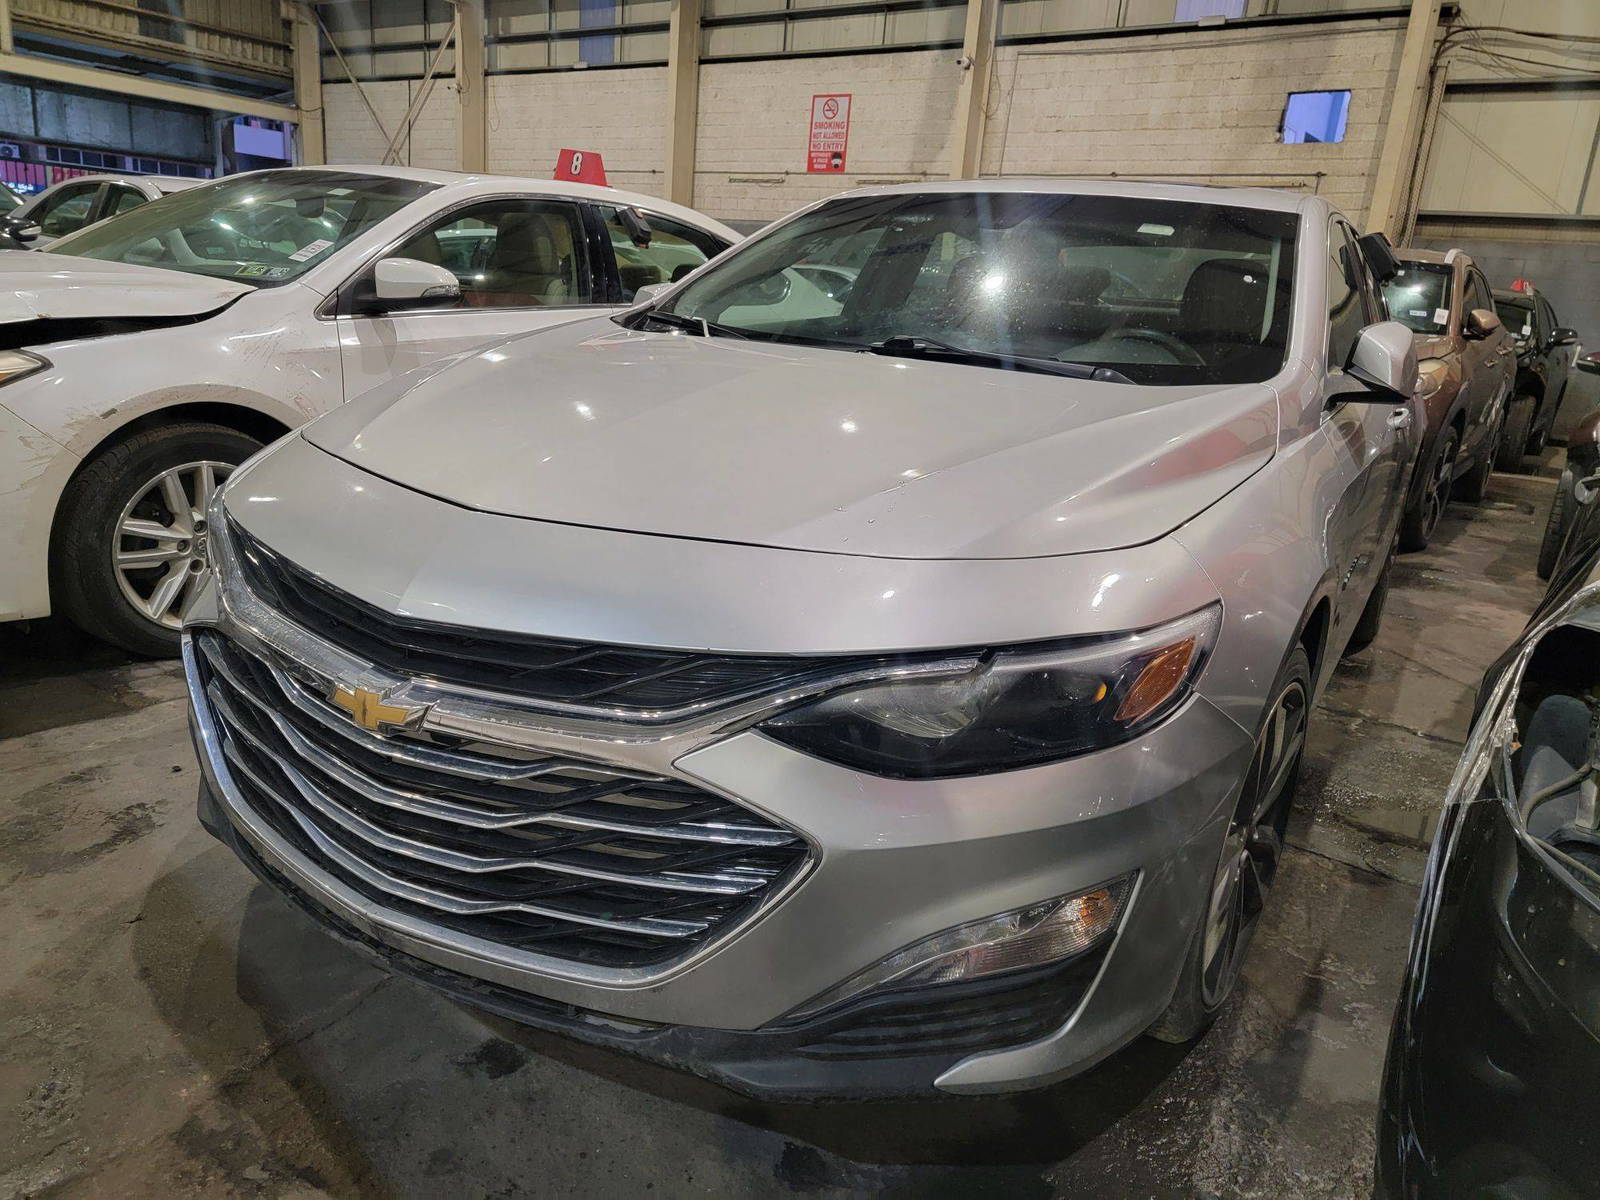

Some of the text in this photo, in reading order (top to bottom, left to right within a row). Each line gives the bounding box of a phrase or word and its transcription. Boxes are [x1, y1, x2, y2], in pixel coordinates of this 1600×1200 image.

[814, 121, 846, 129] SMOKING
[813, 131, 845, 139] NOT ALLOWED
[812, 142, 844, 150] NO ENTRY
[570, 151, 583, 175] 8
